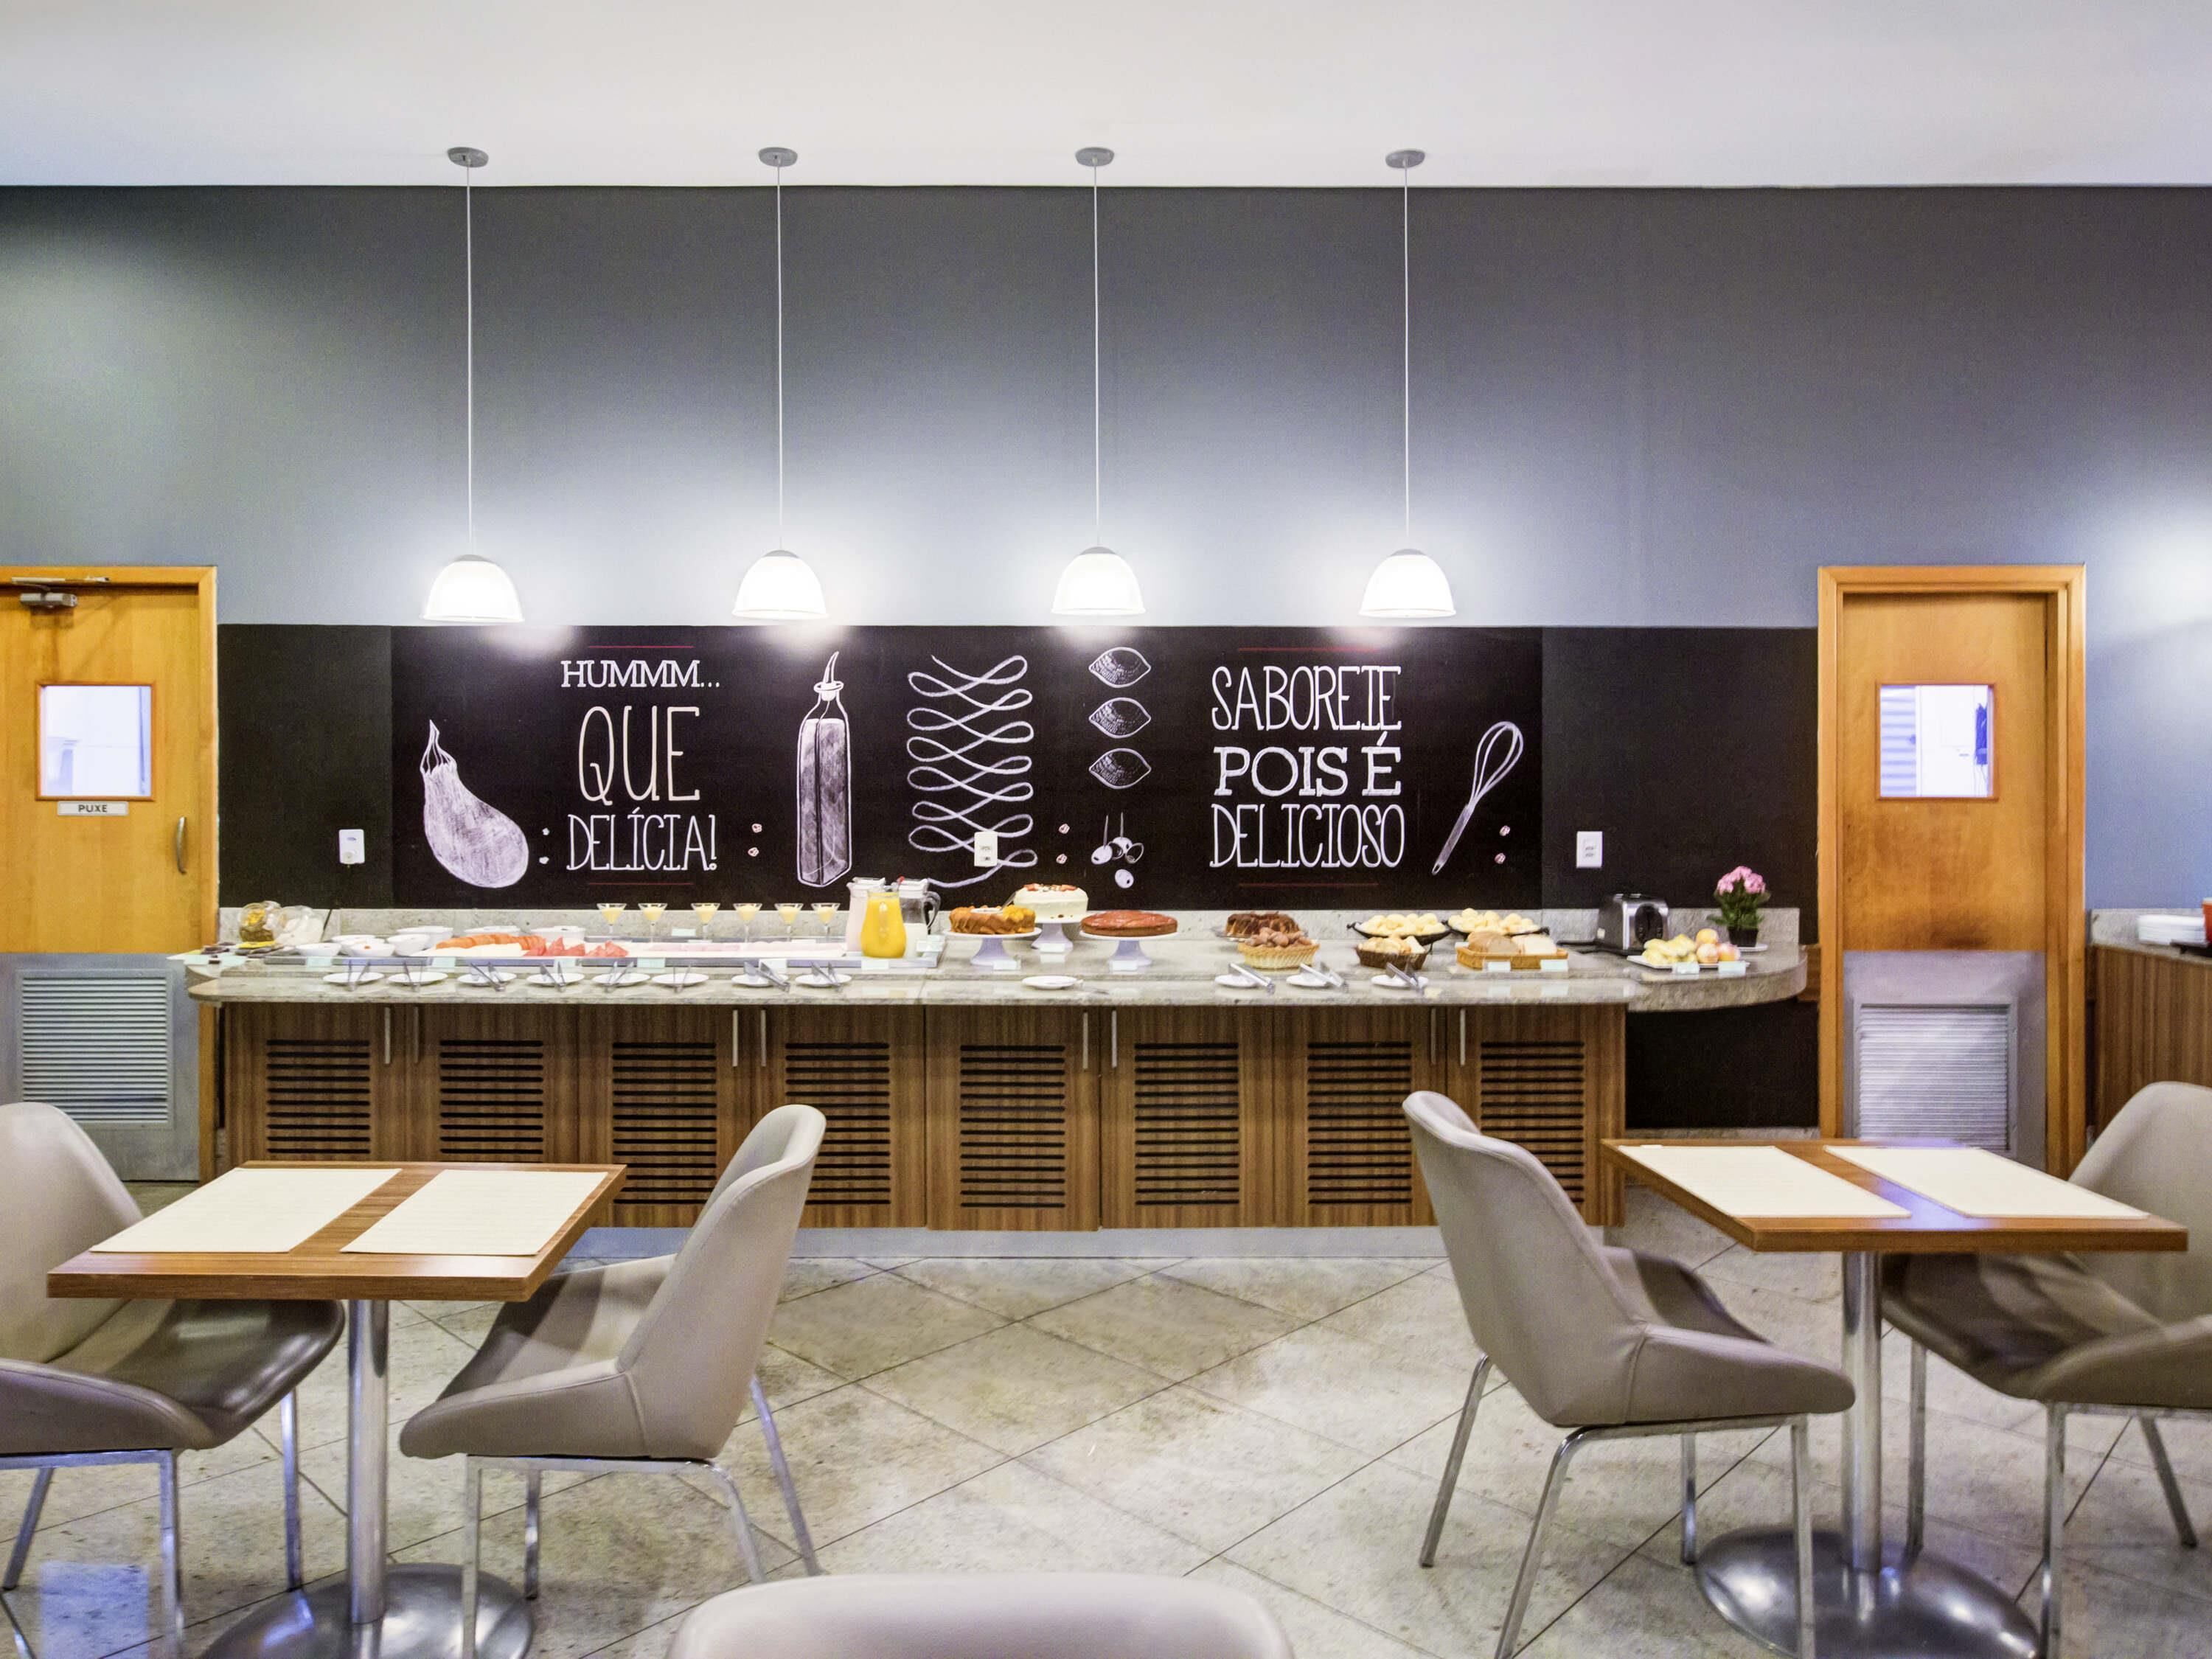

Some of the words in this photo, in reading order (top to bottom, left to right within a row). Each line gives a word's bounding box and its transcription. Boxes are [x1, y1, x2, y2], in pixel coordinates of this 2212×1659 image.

[561, 659, 720, 688] HUMMM...
[578, 705, 700, 806] QUE
[1213, 746, 1349, 797] POIS
[1360, 731, 1402, 796] É
[77, 804, 108, 813] PUXE
[566, 807, 717, 872] DELÍCIA!
[1209, 803, 1405, 868] DELICIOSO
